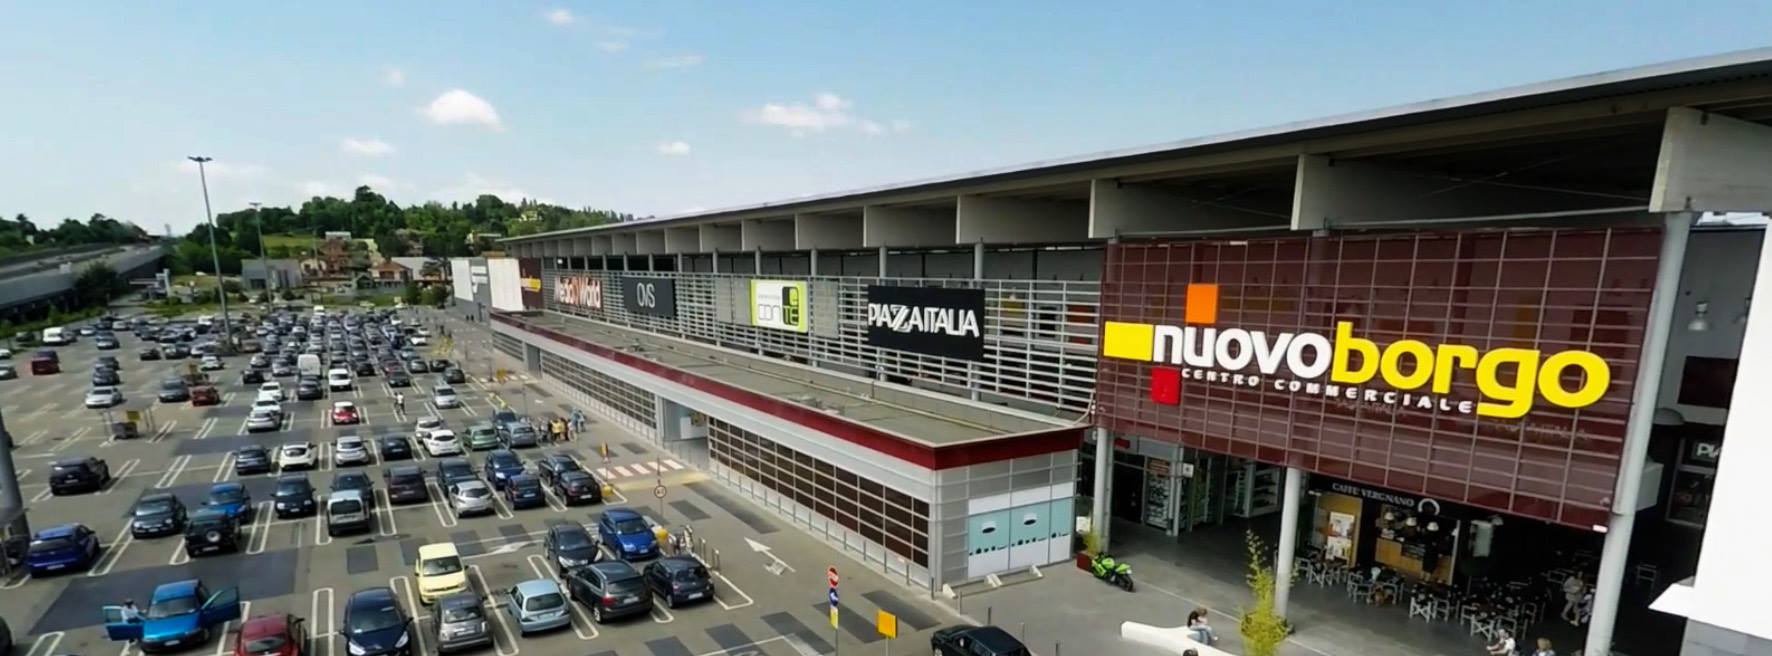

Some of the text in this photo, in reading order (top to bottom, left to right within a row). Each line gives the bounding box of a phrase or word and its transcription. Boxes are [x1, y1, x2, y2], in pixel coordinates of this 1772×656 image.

[637, 282, 656, 308] OVS
[1181, 368, 1260, 387] CENTRO
[1274, 378, 1473, 414] COMMERCIALE
[1361, 488, 1415, 507] VERGNANO
